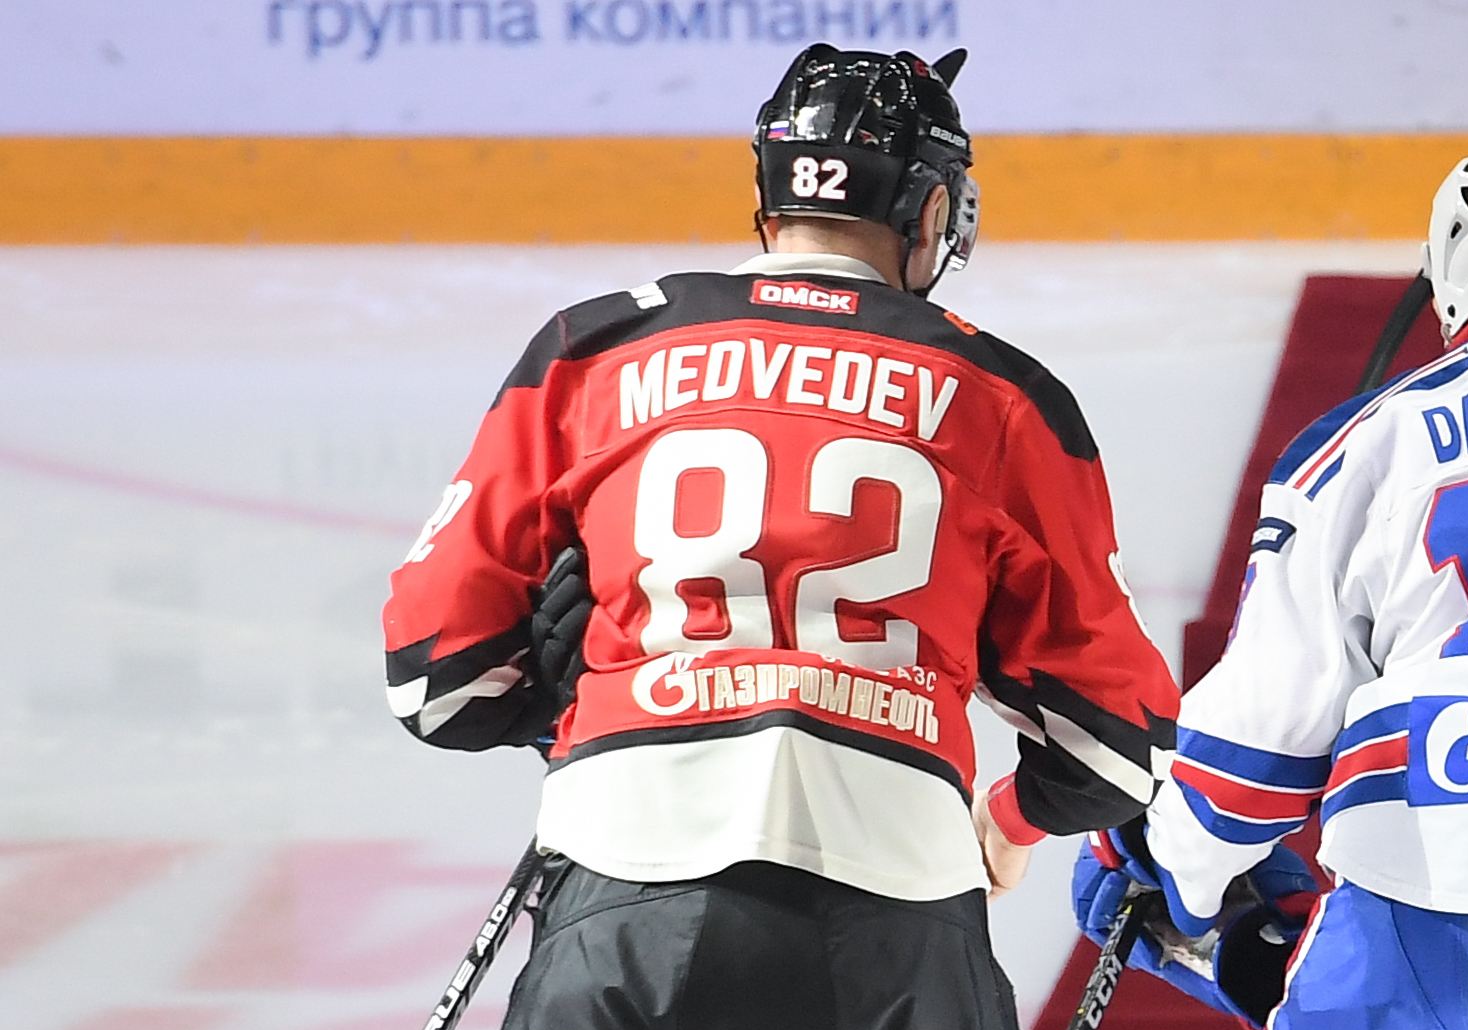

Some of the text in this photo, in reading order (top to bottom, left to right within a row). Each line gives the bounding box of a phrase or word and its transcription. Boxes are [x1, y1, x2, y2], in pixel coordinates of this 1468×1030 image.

[264, 0, 962, 60] группа компании
[930, 126, 967, 150] BAUE
[791, 156, 848, 200] 82
[759, 284, 851, 310] ОМСК
[619, 337, 960, 441] MEDVEDEV
[634, 428, 943, 669] 82
[696, 663, 940, 744] ГАЗПРОМНЕФТЬ
[1085, 953, 1123, 1030] CCM
